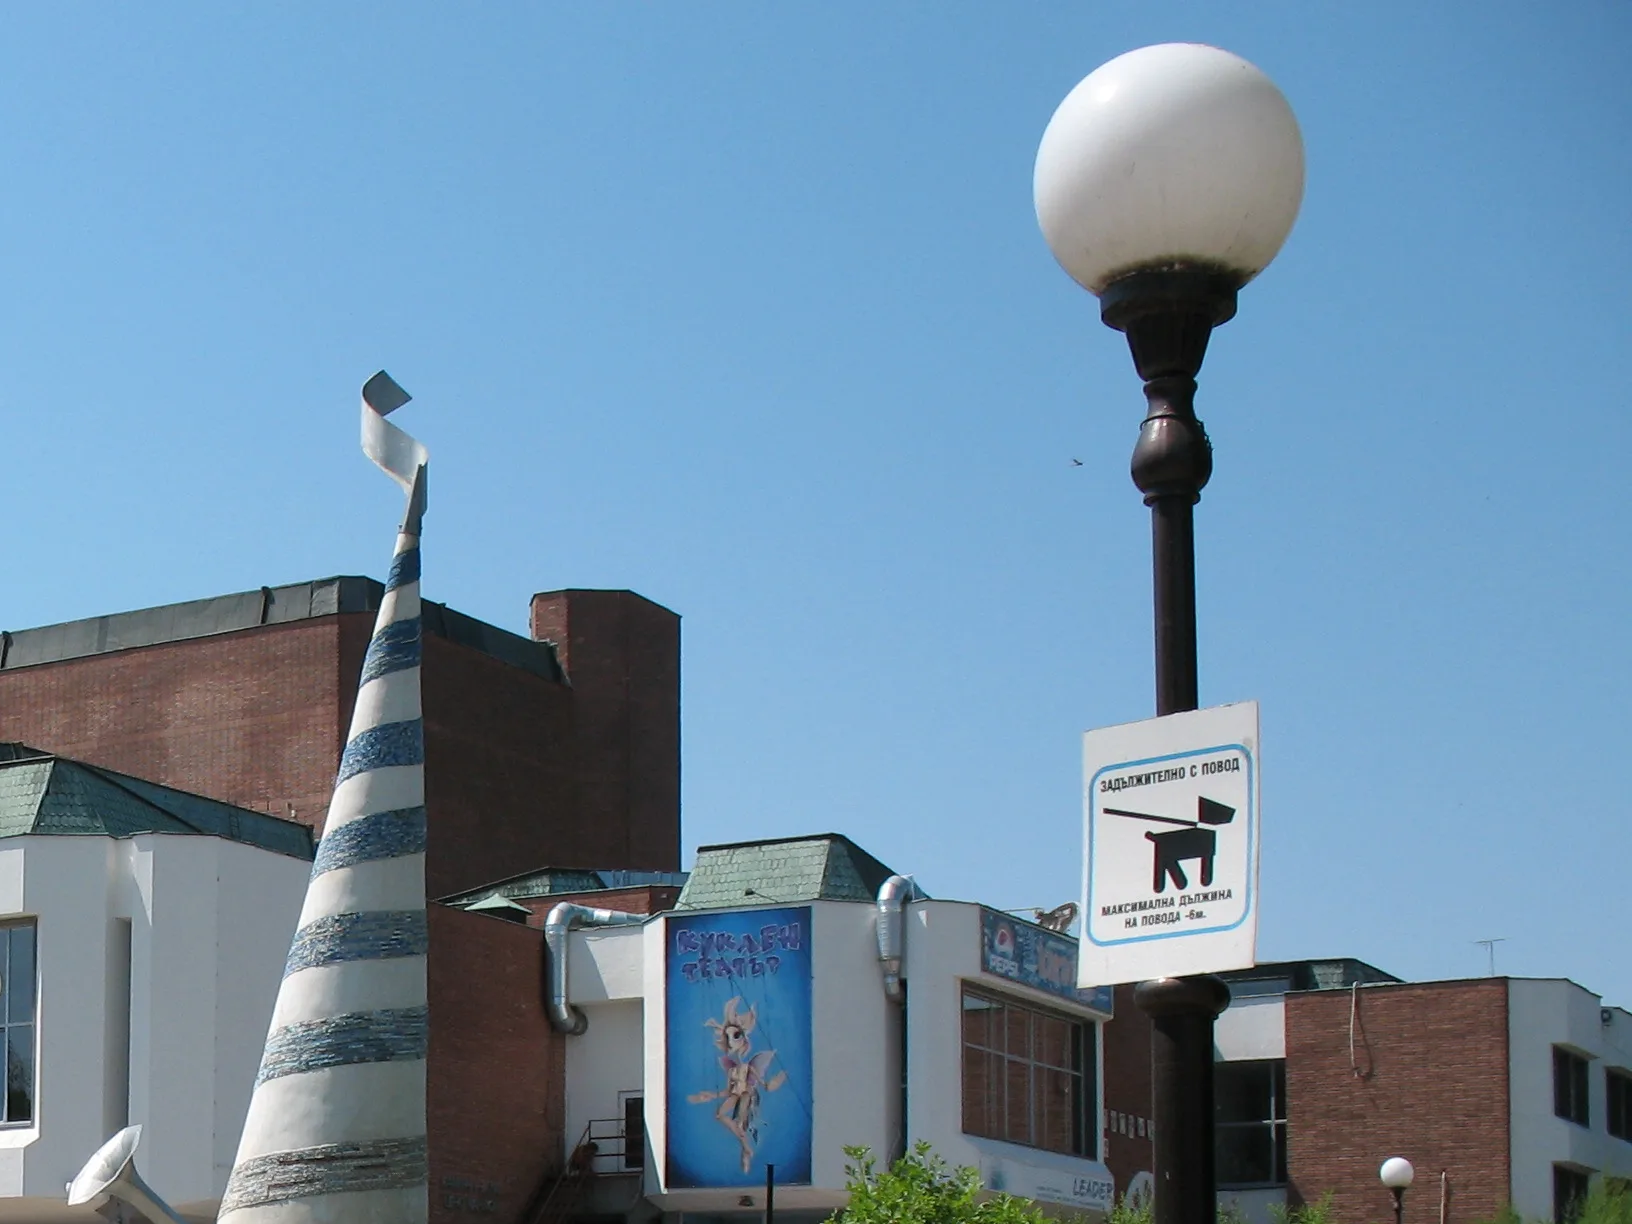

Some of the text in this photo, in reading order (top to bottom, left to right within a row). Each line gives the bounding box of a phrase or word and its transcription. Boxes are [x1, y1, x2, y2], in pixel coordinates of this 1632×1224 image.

[1100, 758, 1240, 792] ЗАДЪЛЖИТЕЛНО С ПОВОД
[1101, 889, 1232, 916] МАКСИМАЛНА ДЪЛЖИНА
[1124, 917, 1137, 928] НА
[1141, 911, 1180, 925] ПОВОДА
[676, 922, 800, 957] КУКЛЕН
[681, 955, 780, 983] ТЕАТЪР
[988, 954, 1020, 977] PEPSI
[1073, 1177, 1113, 1201] LEADER
